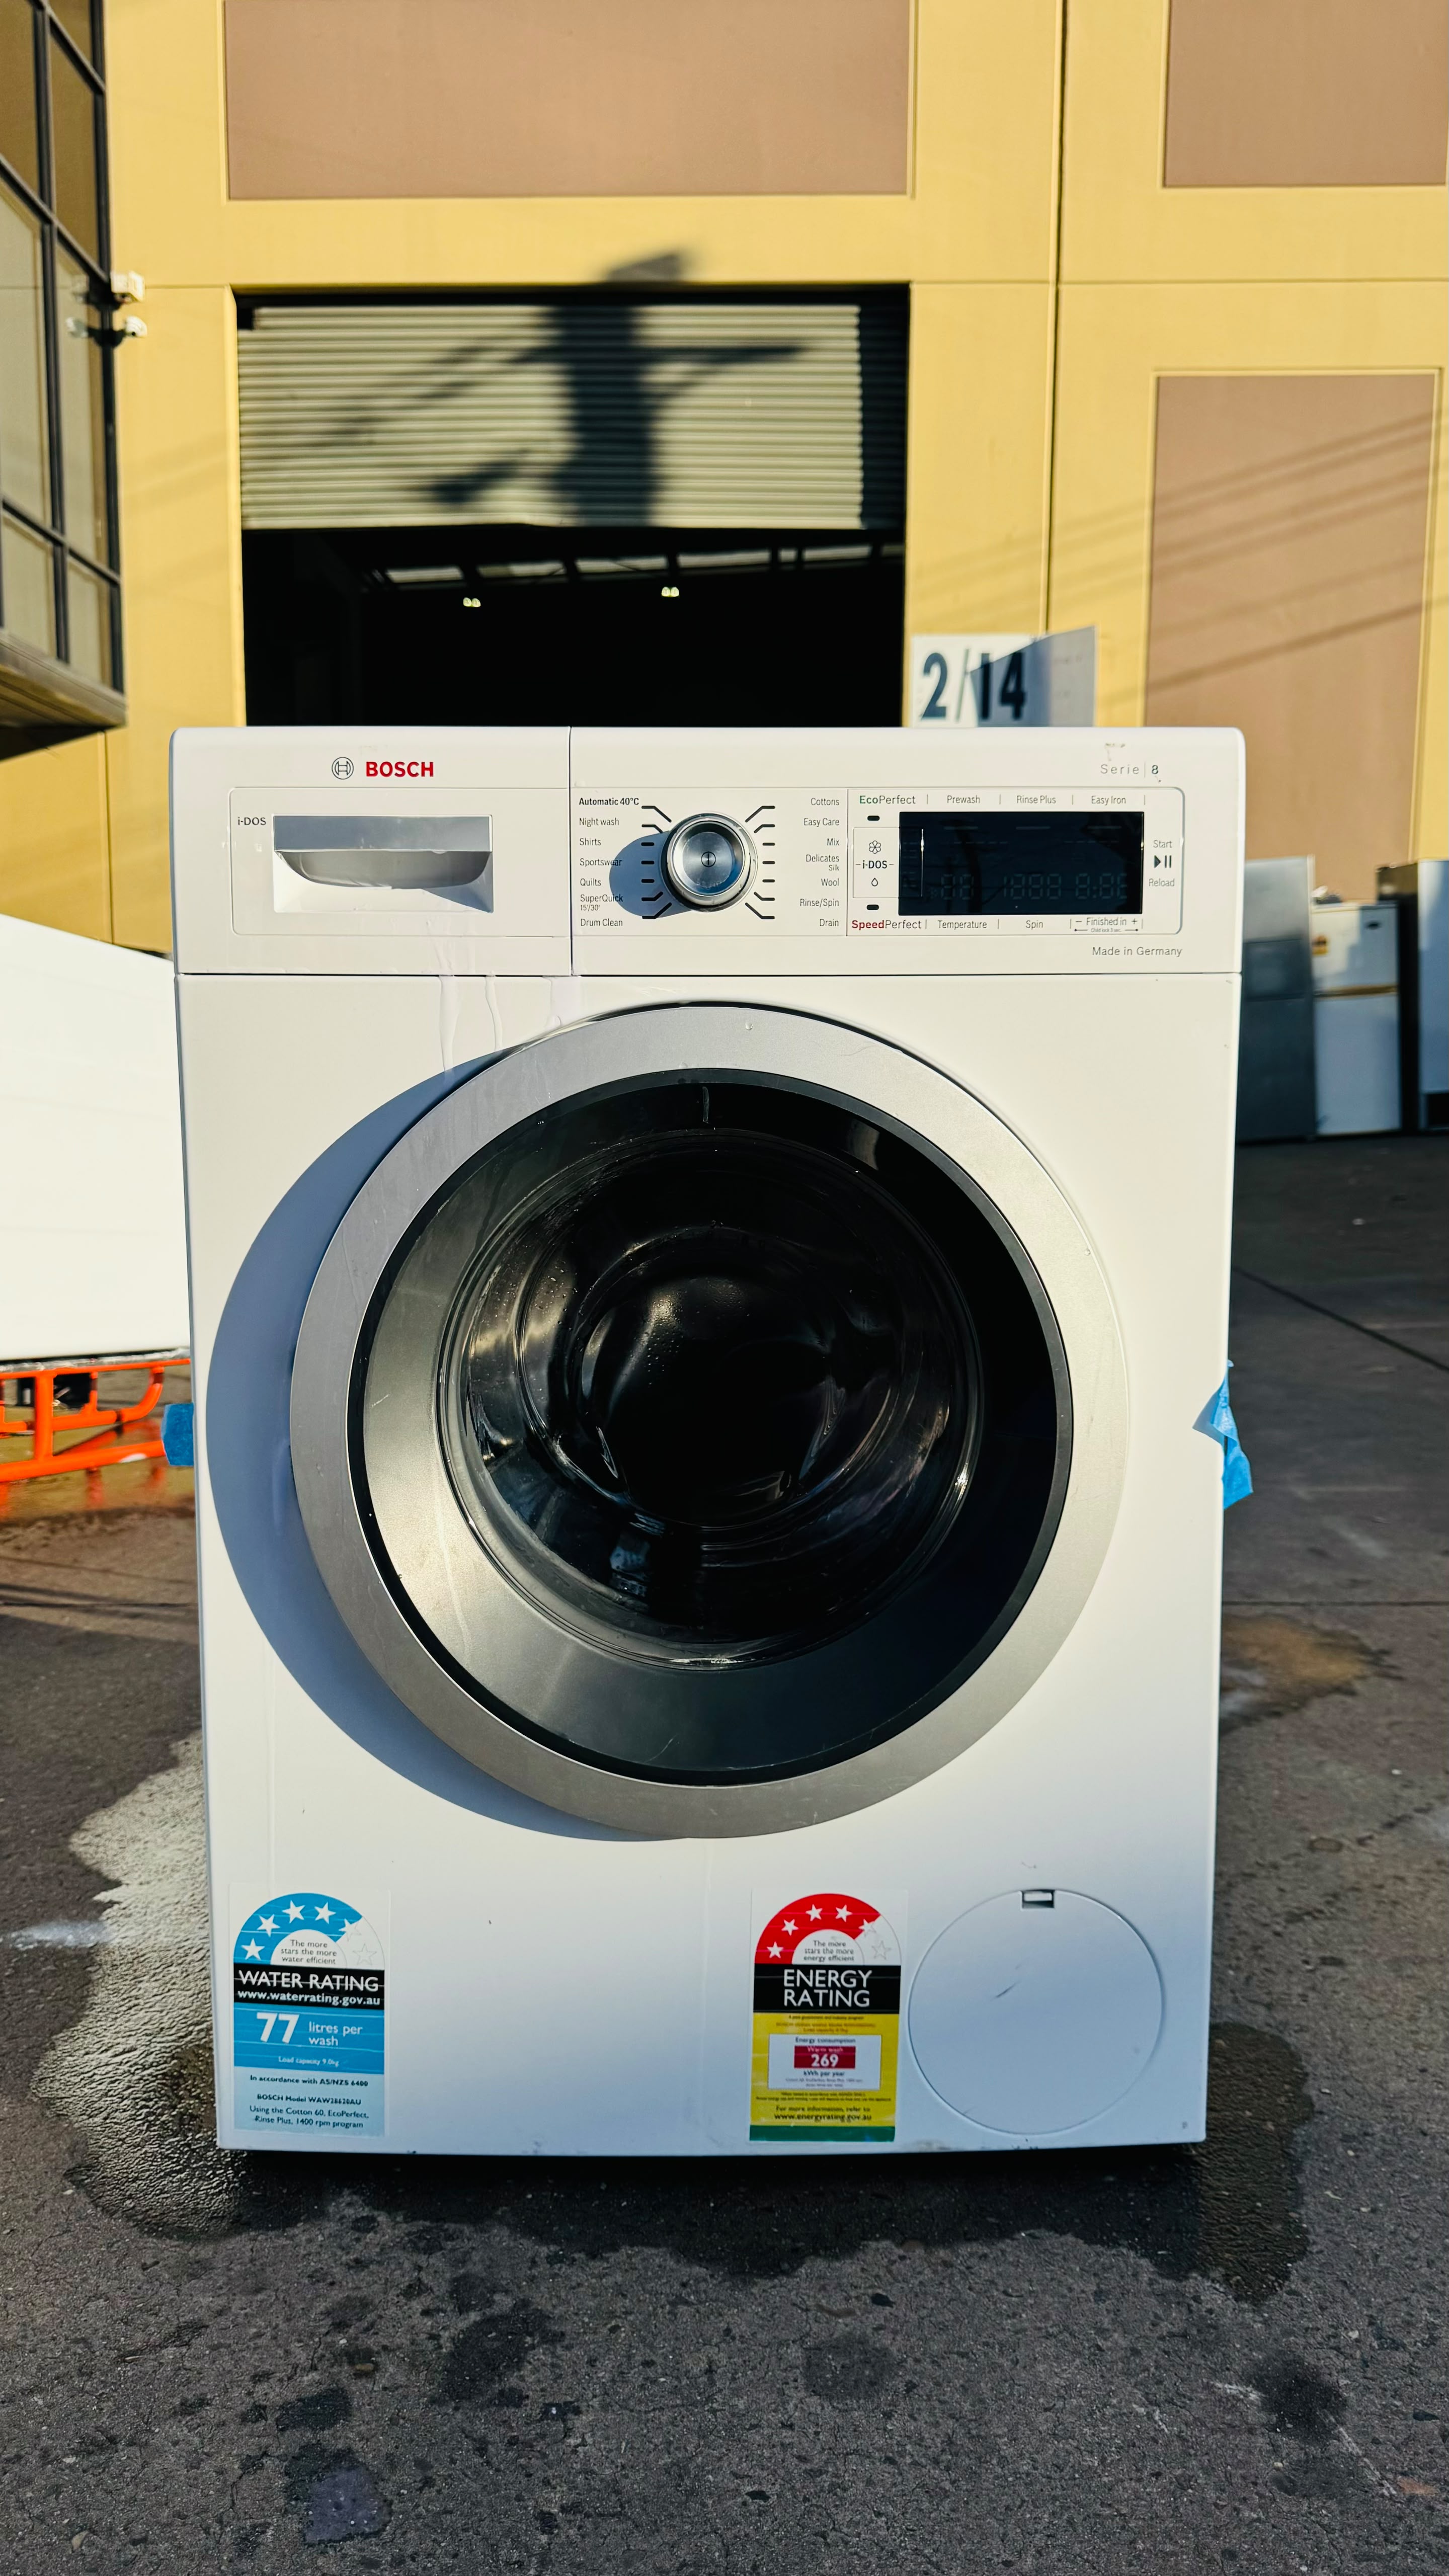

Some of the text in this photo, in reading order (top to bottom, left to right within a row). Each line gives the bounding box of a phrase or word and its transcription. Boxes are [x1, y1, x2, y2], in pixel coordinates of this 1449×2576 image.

[921, 649, 1027, 722] 2/14
[366, 761, 434, 777] BOSCH
[1100, 764, 1159, 774] Serie 8
[579, 797, 639, 806] Automatic 40°C
[811, 797, 840, 806] Cottons
[859, 795, 916, 804] EcoPerfect
[947, 795, 980, 803] Prewash
[1016, 795, 1056, 803] Rinse Plus
[1091, 795, 1126, 805] Easy Iron
[237, 816, 267, 826] i-DOS
[579, 818, 619, 827] Night wash
[803, 818, 840, 827] Easy Care
[580, 838, 601, 846] Shirts
[827, 838, 840, 846] Mix
[1153, 840, 1172, 848] Start
[580, 858, 622, 867] Sportswear
[806, 854, 840, 862] Delicates
[862, 860, 888, 869] i-DOS
[580, 878, 601, 886] Quilts
[821, 878, 839, 886] Wool
[1149, 878, 1175, 887] Reload
[580, 894, 623, 903] SuperQuick
[800, 898, 839, 908] Rinse/Spin
[581, 918, 623, 926] Drum Clean
[819, 918, 839, 926] Drain
[852, 920, 922, 930] SpeedPerfect
[938, 920, 987, 930] Temperature
[1025, 920, 1043, 929] Spin
[1086, 917, 1126, 925] Finished in
[1092, 946, 1182, 957] Made in Germany
[290, 1939, 304, 1947] The
[306, 1957, 336, 1965] efficient
[238, 1970, 378, 1992] WATER RATING
[784, 1969, 872, 1988] ENERGY
[237, 1990, 380, 2005] www.waterrating.gov.au
[784, 1989, 870, 2007] RATING
[256, 2012, 300, 2044] 77
[308, 2021, 363, 2037] litres per
[308, 2036, 339, 2047] wash
[811, 2053, 839, 2067] 269
[250, 2105, 270, 2114] Using
[286, 2107, 312, 2116] Cotton
[254, 2115, 275, 2123] Rinse
[296, 2118, 313, 2126] 1400
[333, 2121, 363, 2129] program
